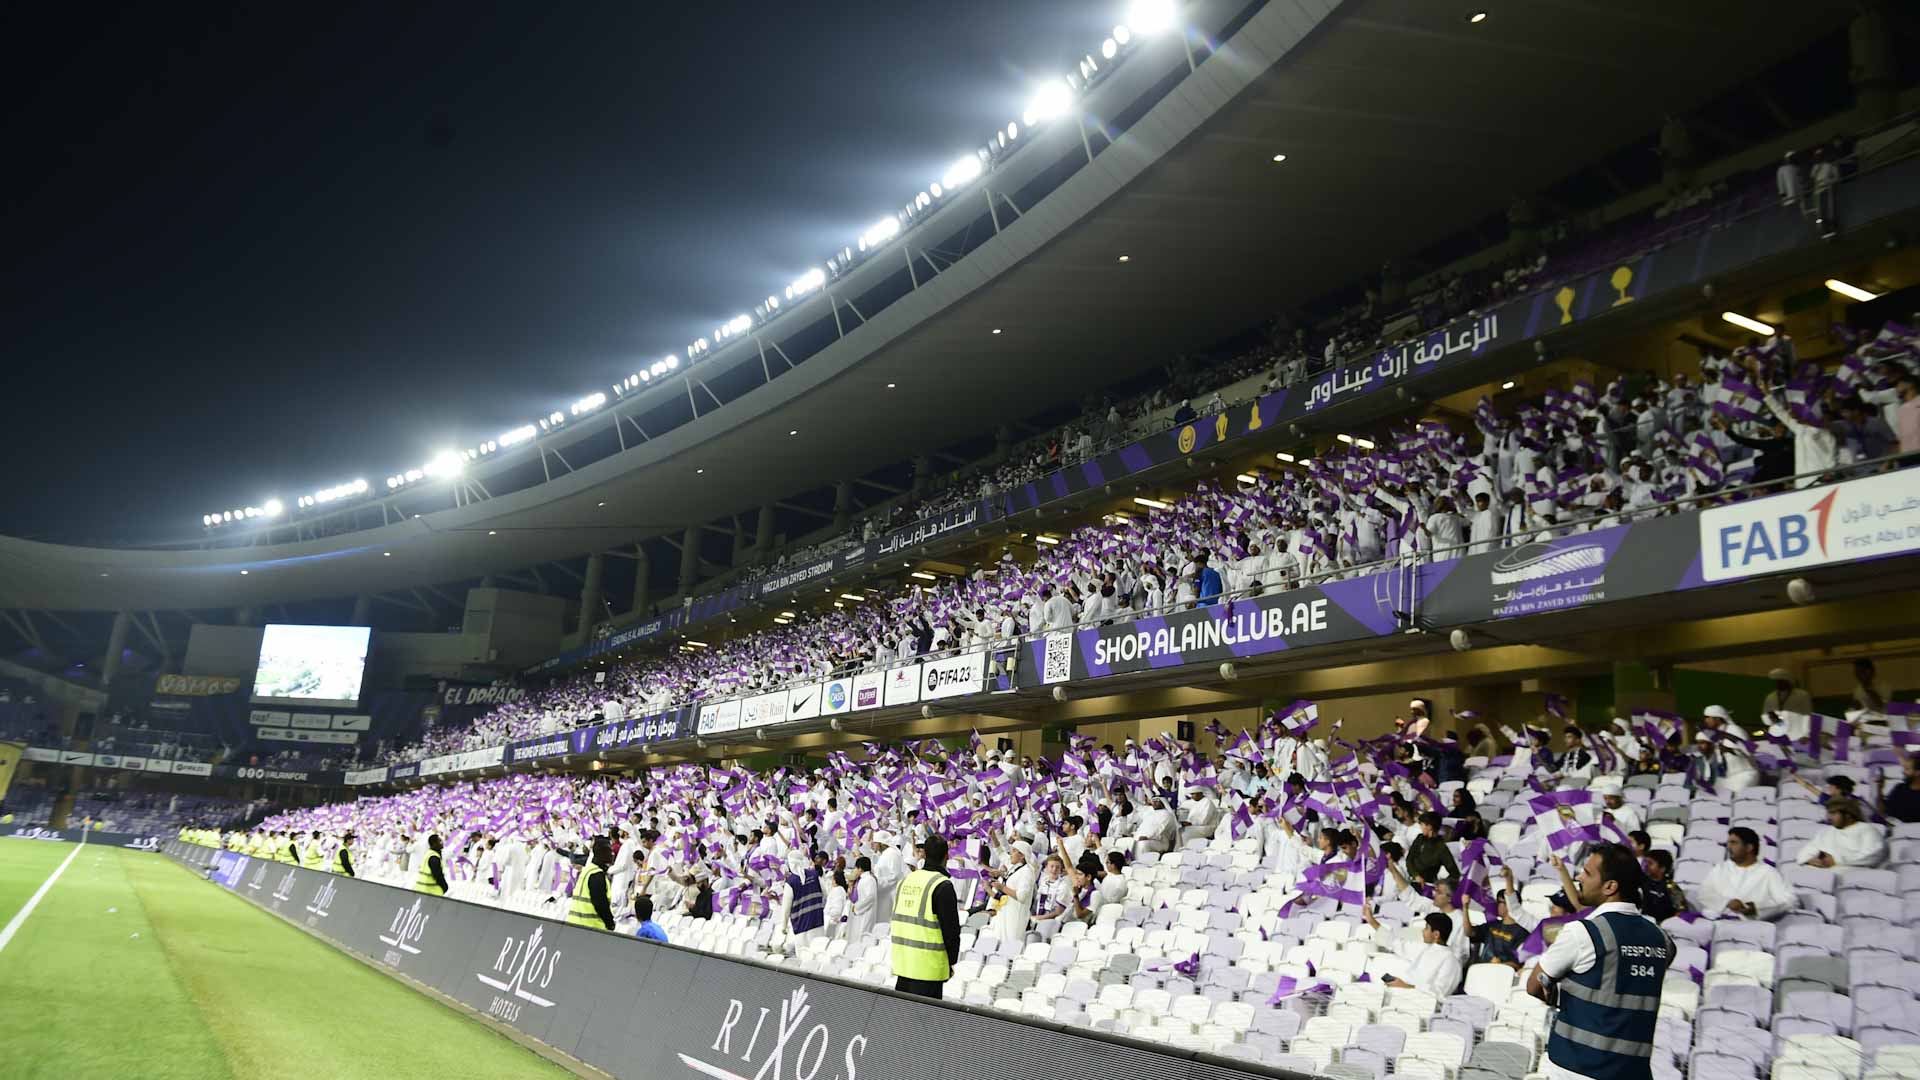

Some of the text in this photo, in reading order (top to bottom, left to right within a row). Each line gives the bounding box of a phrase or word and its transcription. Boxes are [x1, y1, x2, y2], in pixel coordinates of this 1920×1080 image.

[1304, 314, 1498, 410] الزعامة إرث عيناوي
[1719, 513, 1810, 569] FAB
[762, 576, 779, 594] HAZZA
[807, 560, 833, 579] STADIUM
[1094, 598, 1328, 666] SHOP.ALAINCLUB.AE
[939, 668, 958, 686] FIFA
[959, 666, 971, 682] 23
[444, 687, 527, 705] EL DORADO
[700, 712, 715, 730] FAB
[390, 897, 430, 943] RIXOS
[493, 924, 561, 991] RIXOS
[1620, 945, 1667, 959] RESPONSE
[1630, 964, 1656, 977] 584
[489, 996, 522, 1023] HOTELS
[711, 984, 868, 1080] RIXOS
